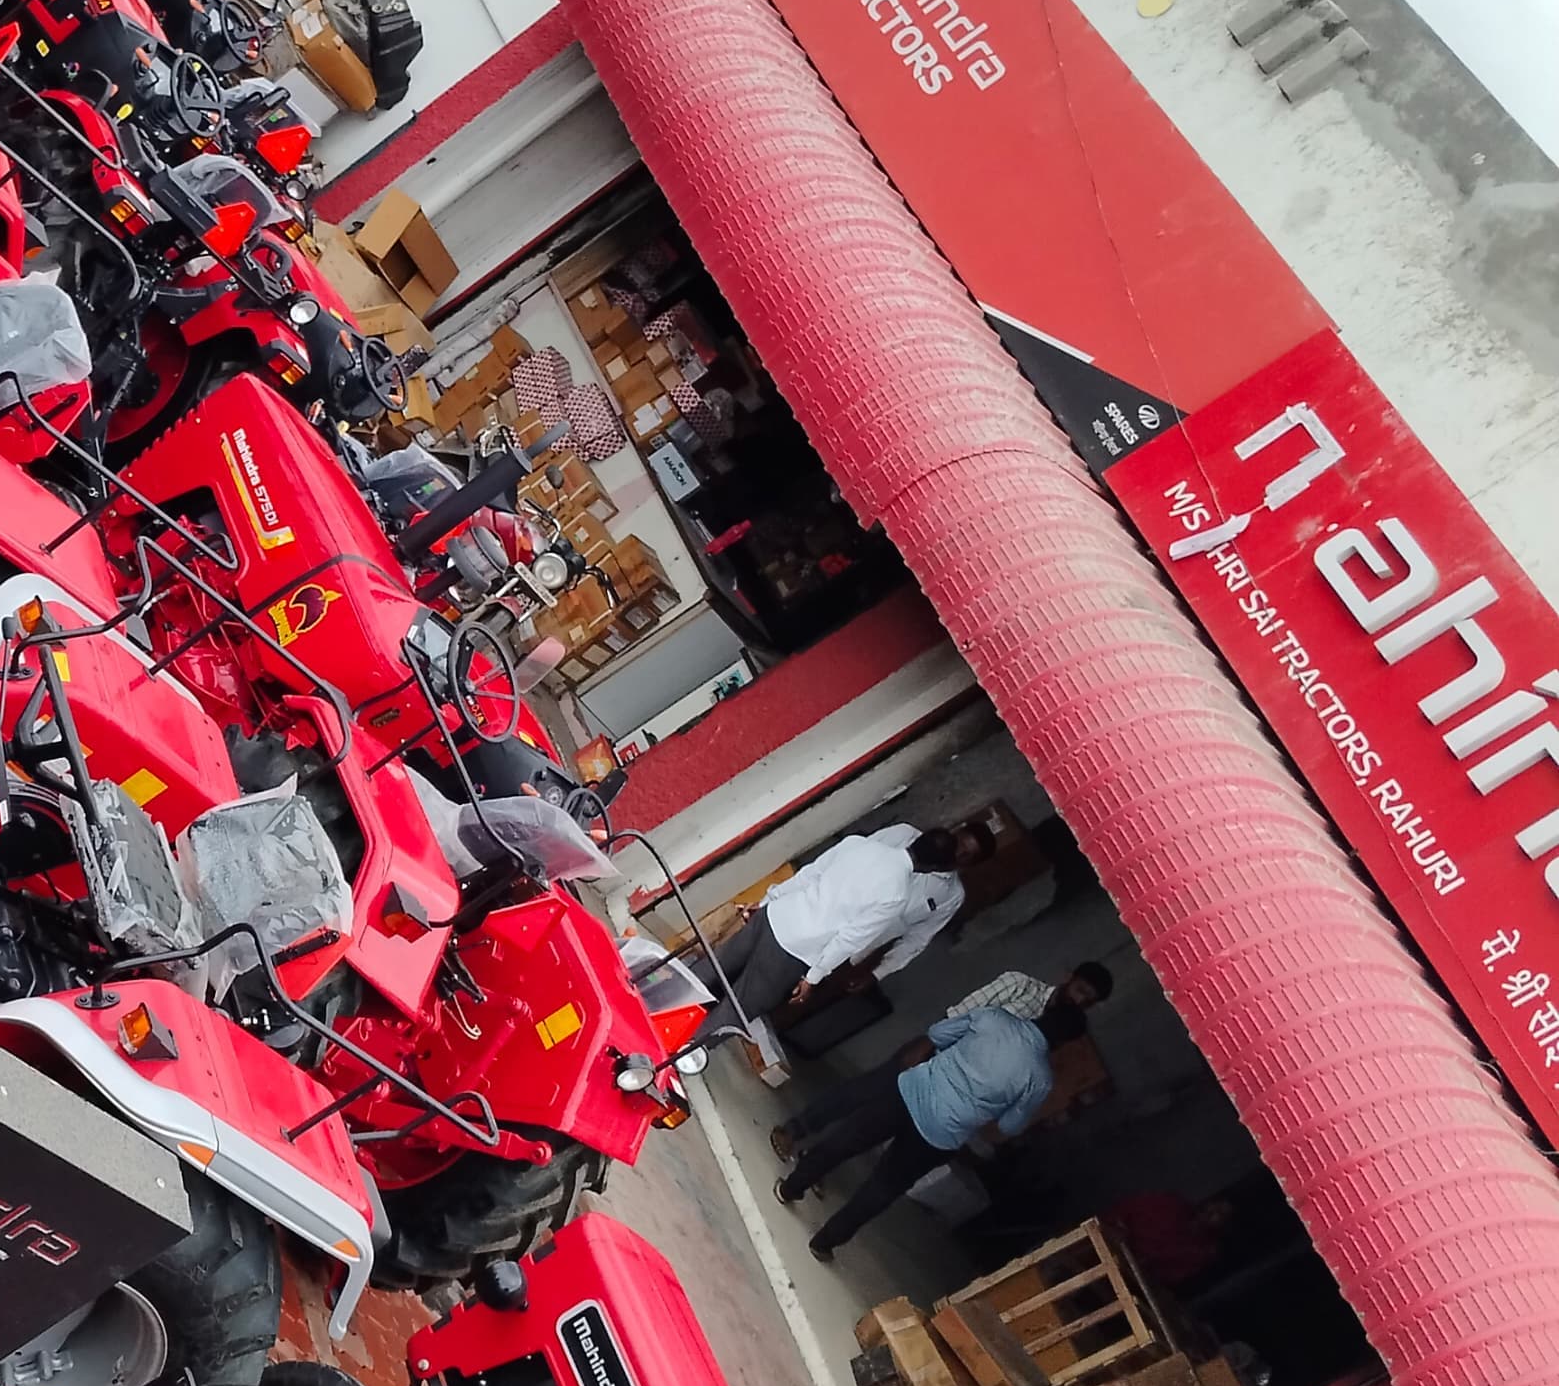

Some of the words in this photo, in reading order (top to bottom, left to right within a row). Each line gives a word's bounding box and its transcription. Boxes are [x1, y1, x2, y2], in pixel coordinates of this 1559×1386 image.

[1104, 402, 1139, 445] SPARES
[232, 428, 261, 486] Mahindra
[1163, 480, 1211, 531] M/S
[1239, 589, 1284, 637] SAI
[1271, 630, 1382, 786] TRACTORS,
[1370, 777, 1466, 896] RAHURI
